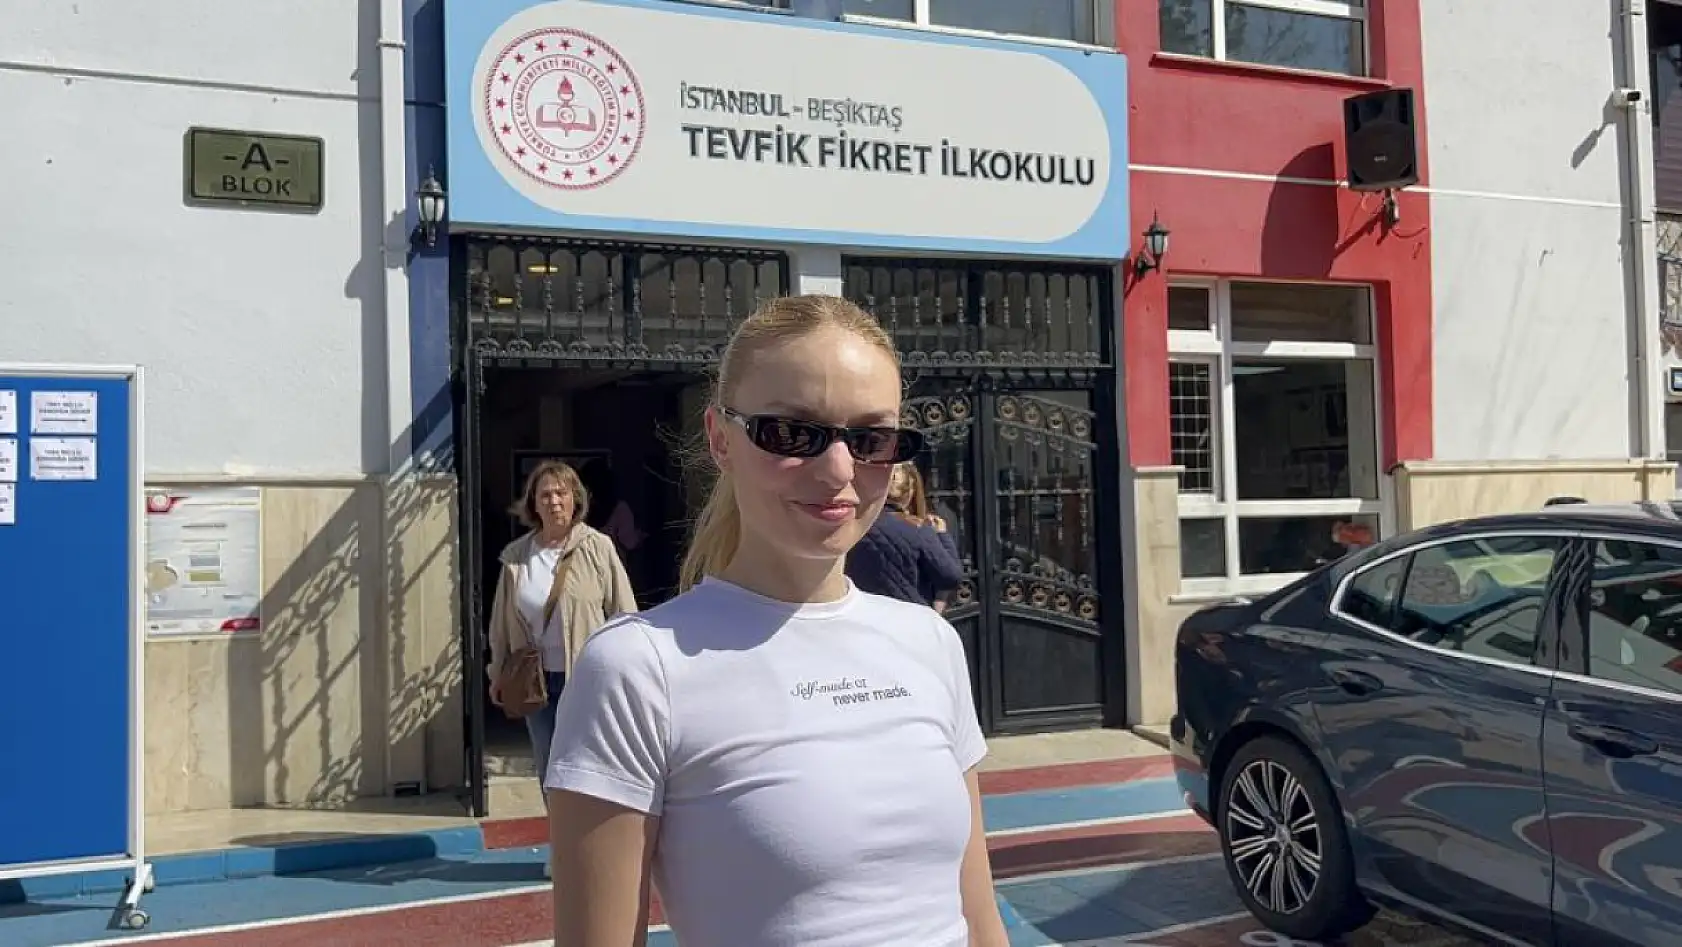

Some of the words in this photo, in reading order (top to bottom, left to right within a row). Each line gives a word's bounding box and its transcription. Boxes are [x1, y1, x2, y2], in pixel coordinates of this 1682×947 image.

[680, 80, 790, 118] İSTANBUL
[807, 97, 903, 132] BEŞİKTAŞ
[681, 123, 811, 164] TEVFİK
[818, 130, 932, 175] FİKRET
[941, 139, 1096, 186] İLKOKULU
[221, 174, 291, 197] BLOK
[789, 677, 853, 700] Self-made
[832, 692, 871, 706] never
[873, 683, 912, 701] made.
